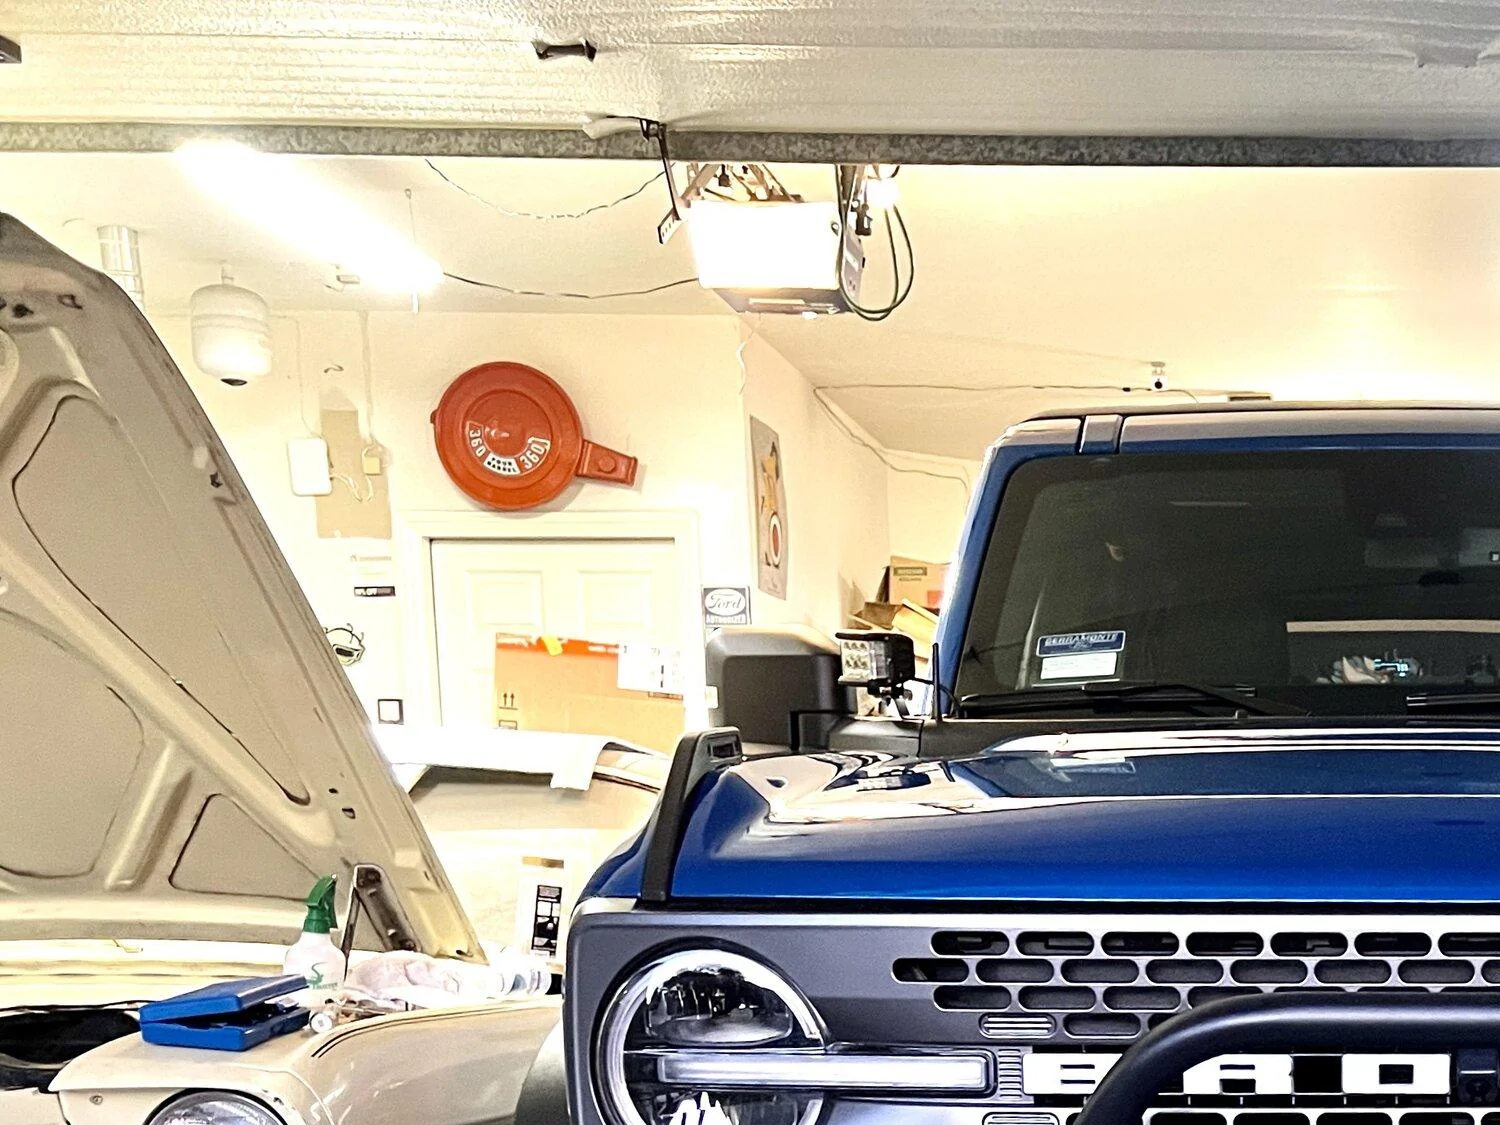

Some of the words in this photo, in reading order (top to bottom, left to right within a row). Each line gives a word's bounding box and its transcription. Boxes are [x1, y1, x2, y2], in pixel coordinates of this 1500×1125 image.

[469, 429, 487, 458] 360
[519, 443, 545, 470] 360
[708, 593, 742, 610] Ford
